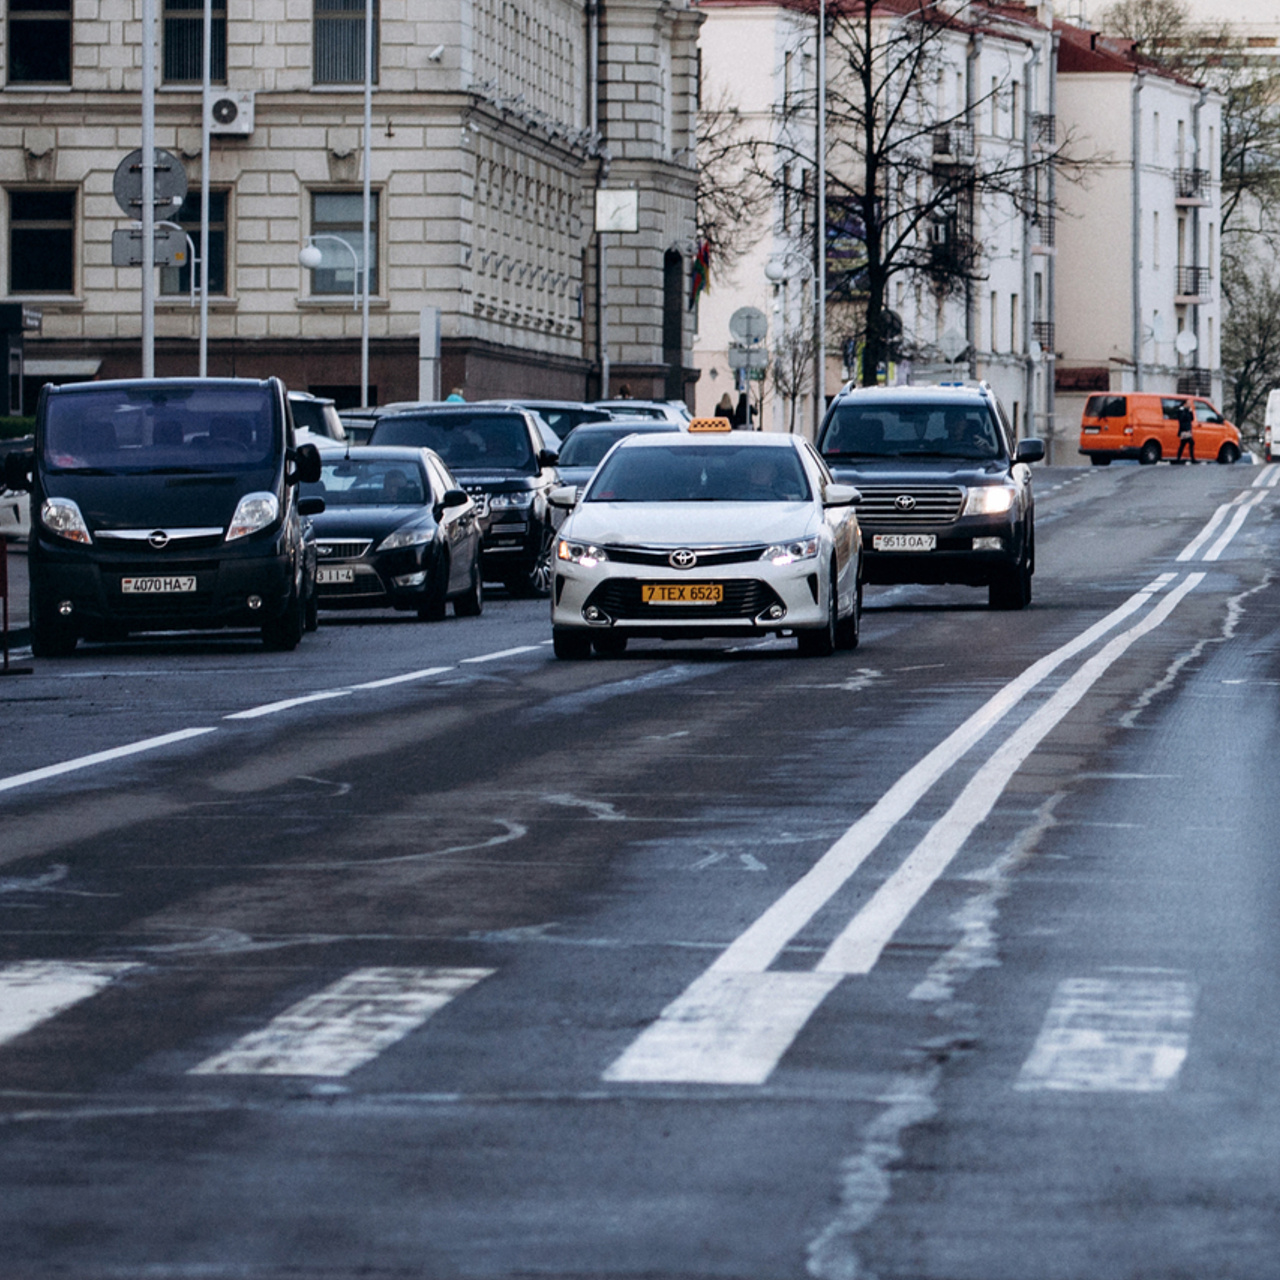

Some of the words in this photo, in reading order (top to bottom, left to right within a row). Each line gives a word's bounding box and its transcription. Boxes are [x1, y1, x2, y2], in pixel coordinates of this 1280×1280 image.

[882, 536, 907, 547] 9513
[133, 578, 162, 591] 4070
[163, 578, 194, 591] HA-7
[648, 587, 656, 600] 7
[659, 587, 686, 600] TEX
[690, 587, 721, 600] 6523
